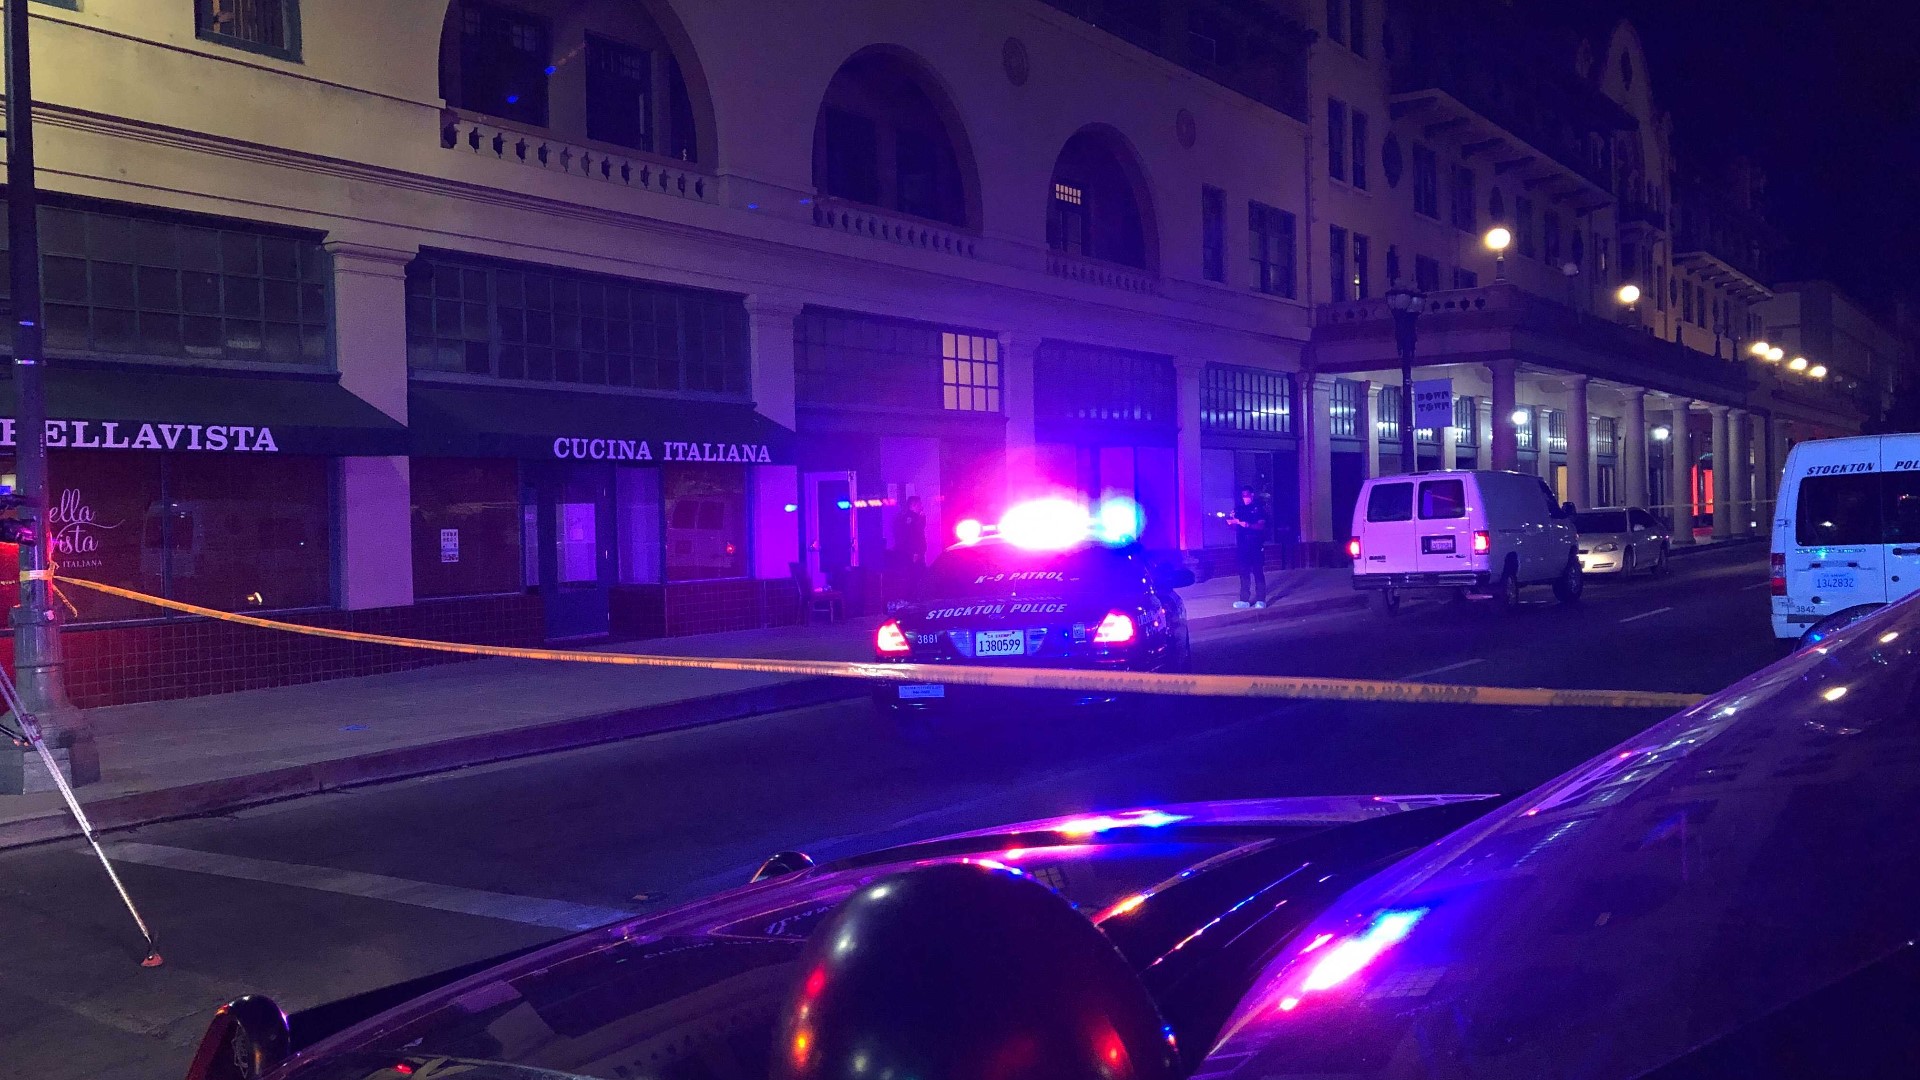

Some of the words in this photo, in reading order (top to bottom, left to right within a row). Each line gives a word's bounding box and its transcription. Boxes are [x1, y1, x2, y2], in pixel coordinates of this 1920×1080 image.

[1417, 391, 1449, 401] DOWN
[1418, 402, 1450, 412] TOWN
[554, 438, 652, 459] CUCINA
[663, 442, 771, 462] ITALIANA
[1807, 463, 1875, 475] STOCKTON
[49, 489, 95, 522] ella
[63, 560, 102, 568] ITALIANA
[975, 574, 1004, 584] K-9
[1009, 571, 1063, 581] PATROL
[1817, 579, 1854, 588] 1342832
[926, 605, 1005, 620] STOCKTON
[1010, 603, 1067, 613] POLICE
[917, 634, 938, 644] 3881
[979, 639, 1021, 652] 1380599
